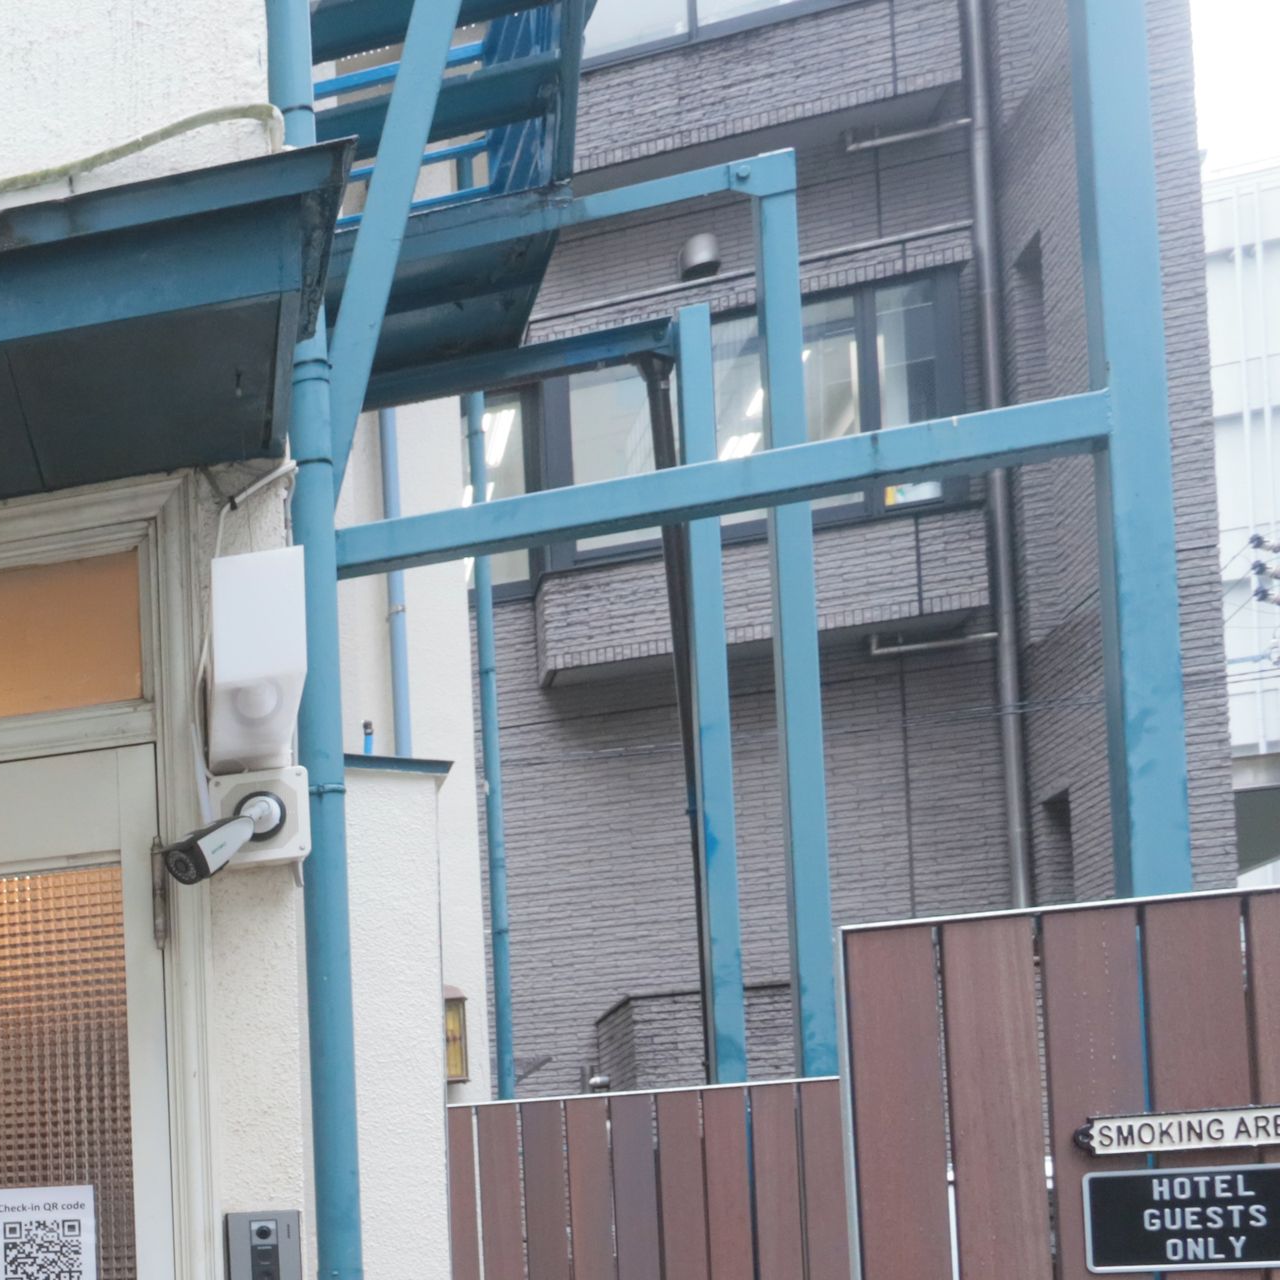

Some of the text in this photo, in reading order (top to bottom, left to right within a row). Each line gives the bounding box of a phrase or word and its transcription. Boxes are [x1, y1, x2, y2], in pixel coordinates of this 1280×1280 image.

[1098, 1118, 1225, 1147] SMOKING
[1152, 1174, 1256, 1201] HOTEL
[43, 1202, 60, 1213] QR
[61, 1201, 86, 1211] code
[1143, 1204, 1268, 1232] GUESTS
[1165, 1235, 1247, 1262] ONLY
